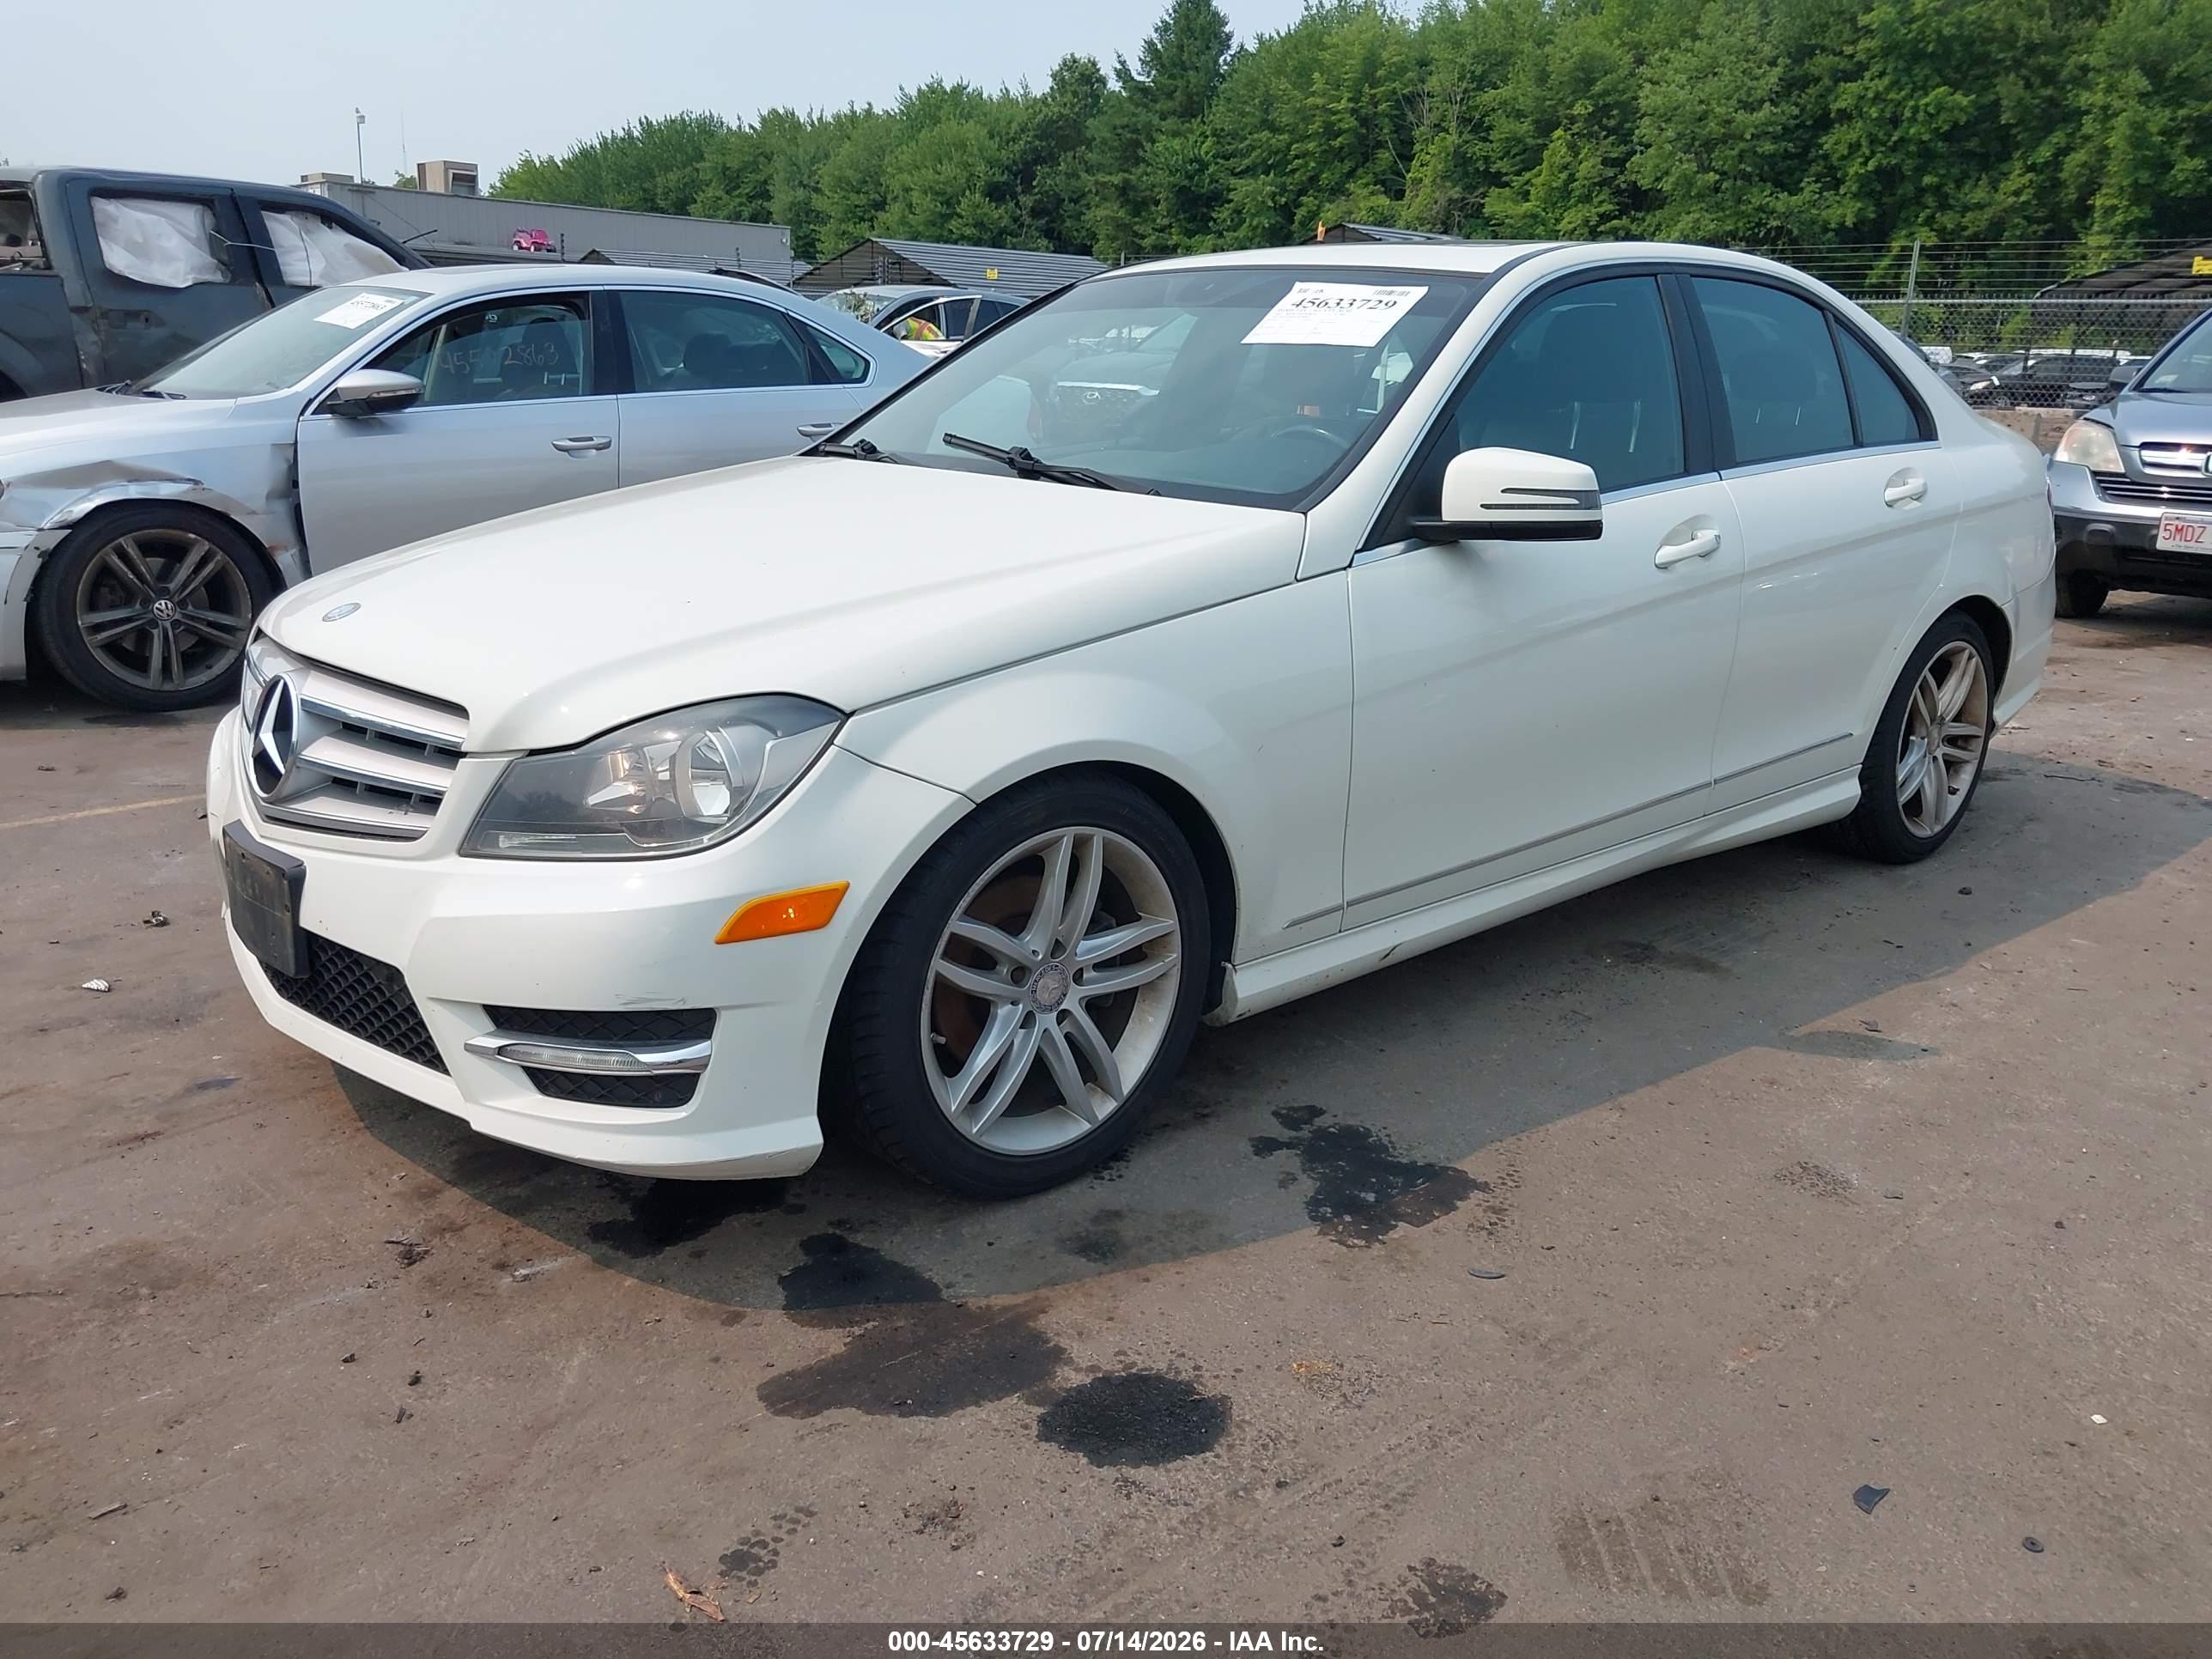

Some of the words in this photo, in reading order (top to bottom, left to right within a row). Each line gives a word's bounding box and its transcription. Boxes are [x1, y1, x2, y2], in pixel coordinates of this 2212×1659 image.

[1291, 297, 1398, 310] 45633729
[439, 343, 558, 374] 4552863
[2162, 523, 2207, 543] 5MDZ
